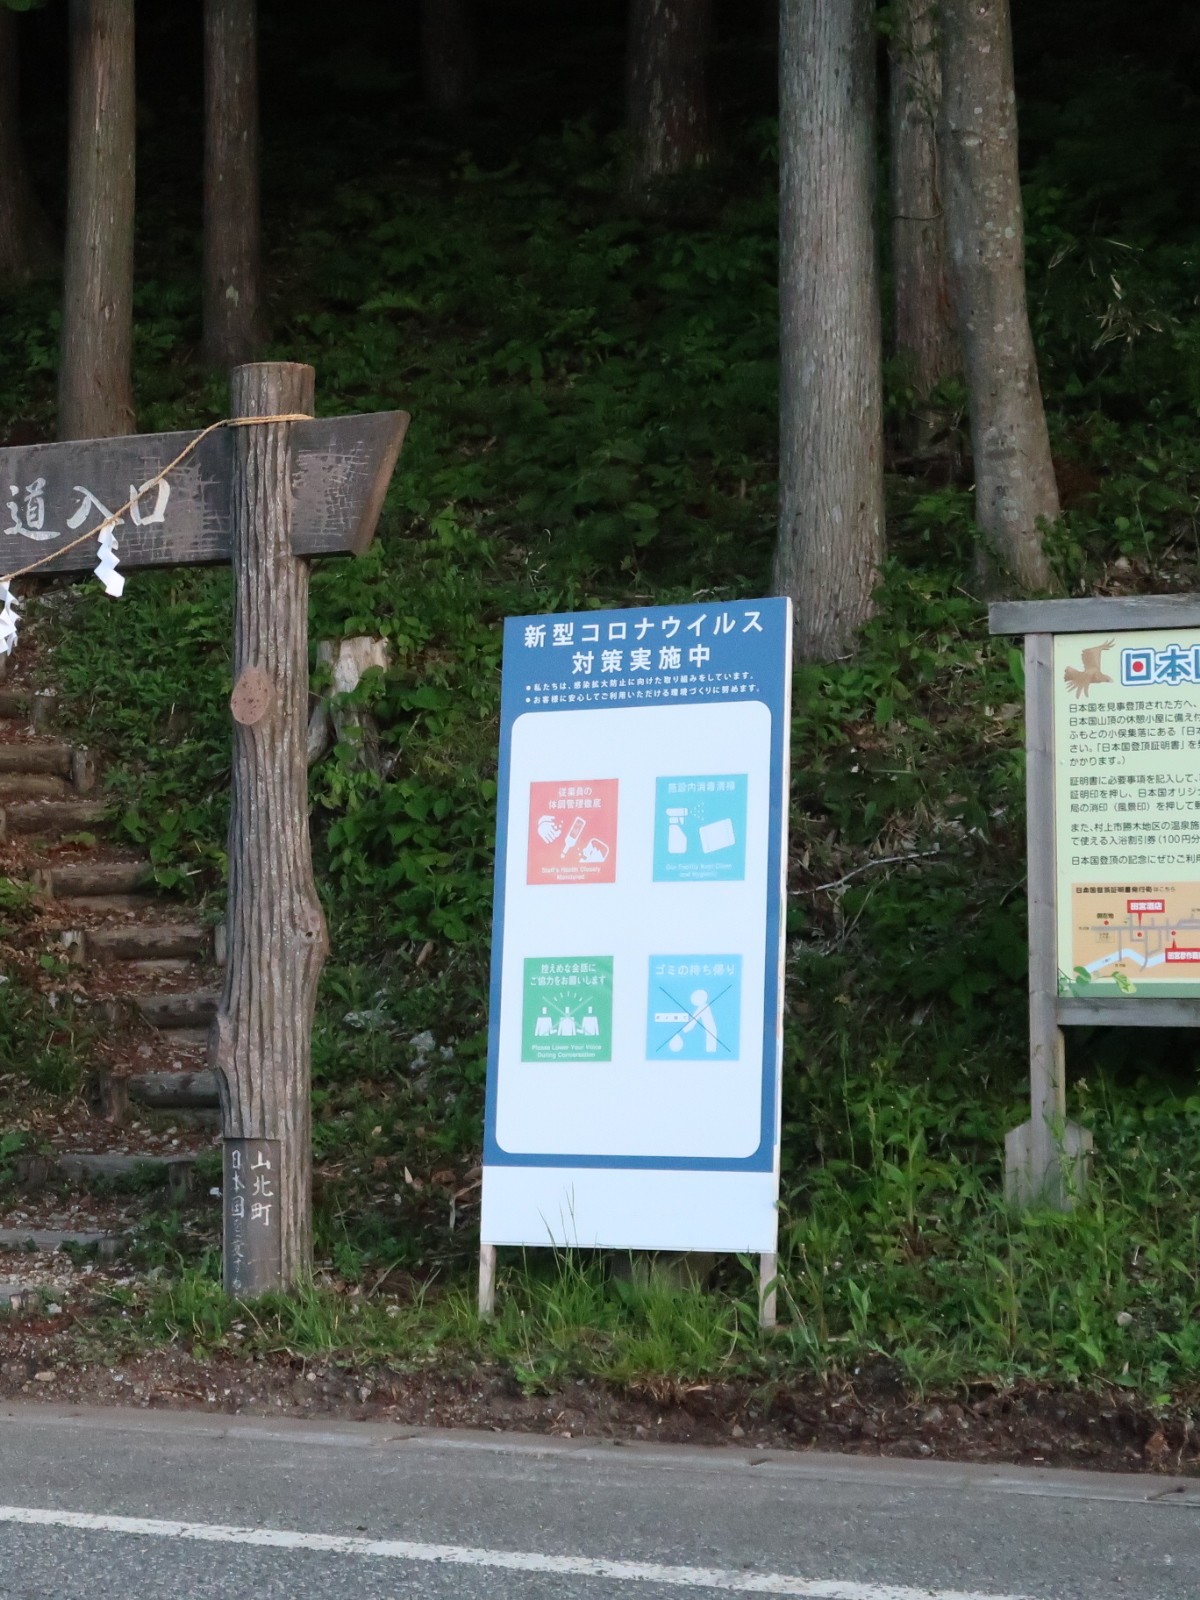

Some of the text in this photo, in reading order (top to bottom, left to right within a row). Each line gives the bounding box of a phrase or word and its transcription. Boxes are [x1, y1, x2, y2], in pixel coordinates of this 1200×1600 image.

[524, 610, 764, 649] 新型コロナウイルス
[571, 643, 711, 675] 対策実施中
[1120, 643, 1200, 686] 日本
[1069, 699, 1197, 713] 日本国を見事登頂された方へ、
[1070, 774, 1200, 786] 証明書に必要事項を記入して、
[558, 786, 592, 797] 従業員の
[541, 962, 597, 974] 控えめな会話に
[655, 963, 735, 976] ゴミの持ち帰り
[530, 975, 606, 986] ご協力をお願いします
[250, 1150, 274, 1226] 山北町
